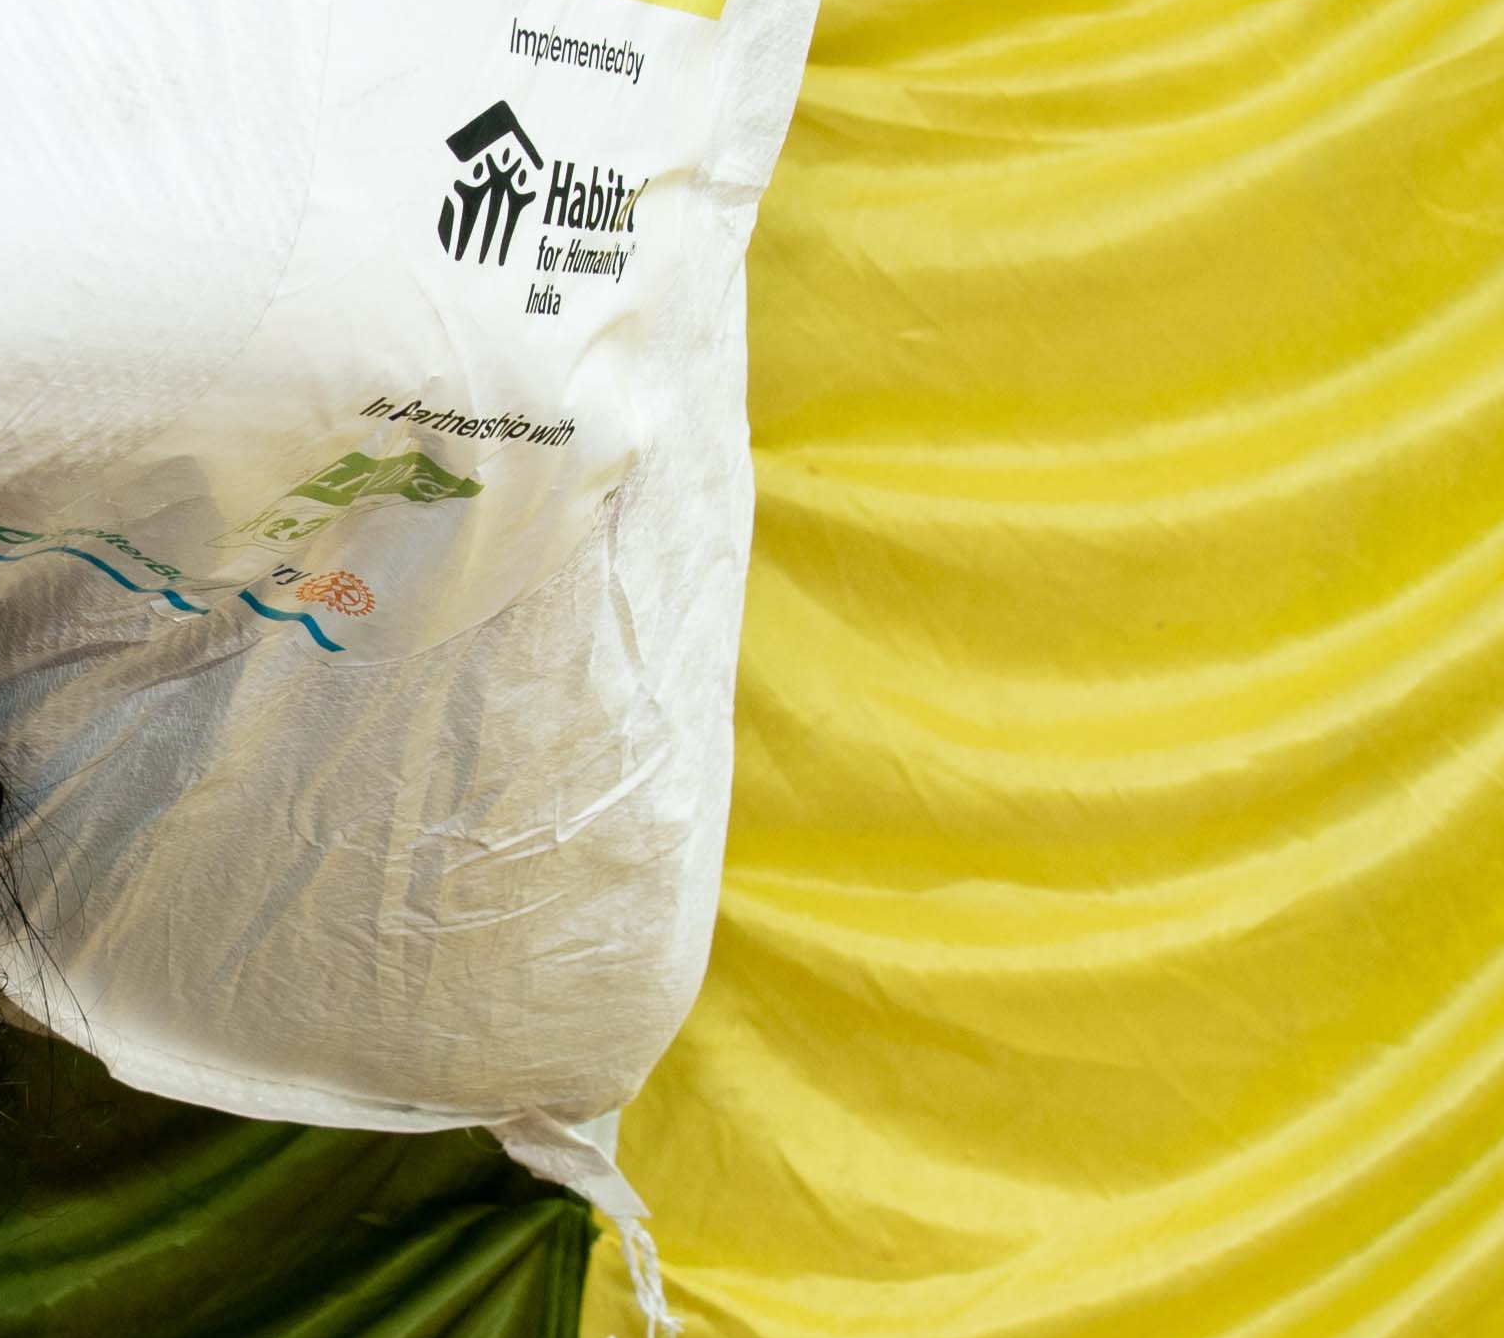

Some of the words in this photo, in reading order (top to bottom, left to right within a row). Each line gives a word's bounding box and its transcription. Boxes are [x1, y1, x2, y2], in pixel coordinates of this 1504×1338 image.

[536, 235, 563, 272] for
[562, 238, 629, 284] Humanity
[525, 283, 561, 315] India
[359, 396, 395, 418] In
[388, 400, 532, 441] Partnership
[527, 418, 575, 446] with
